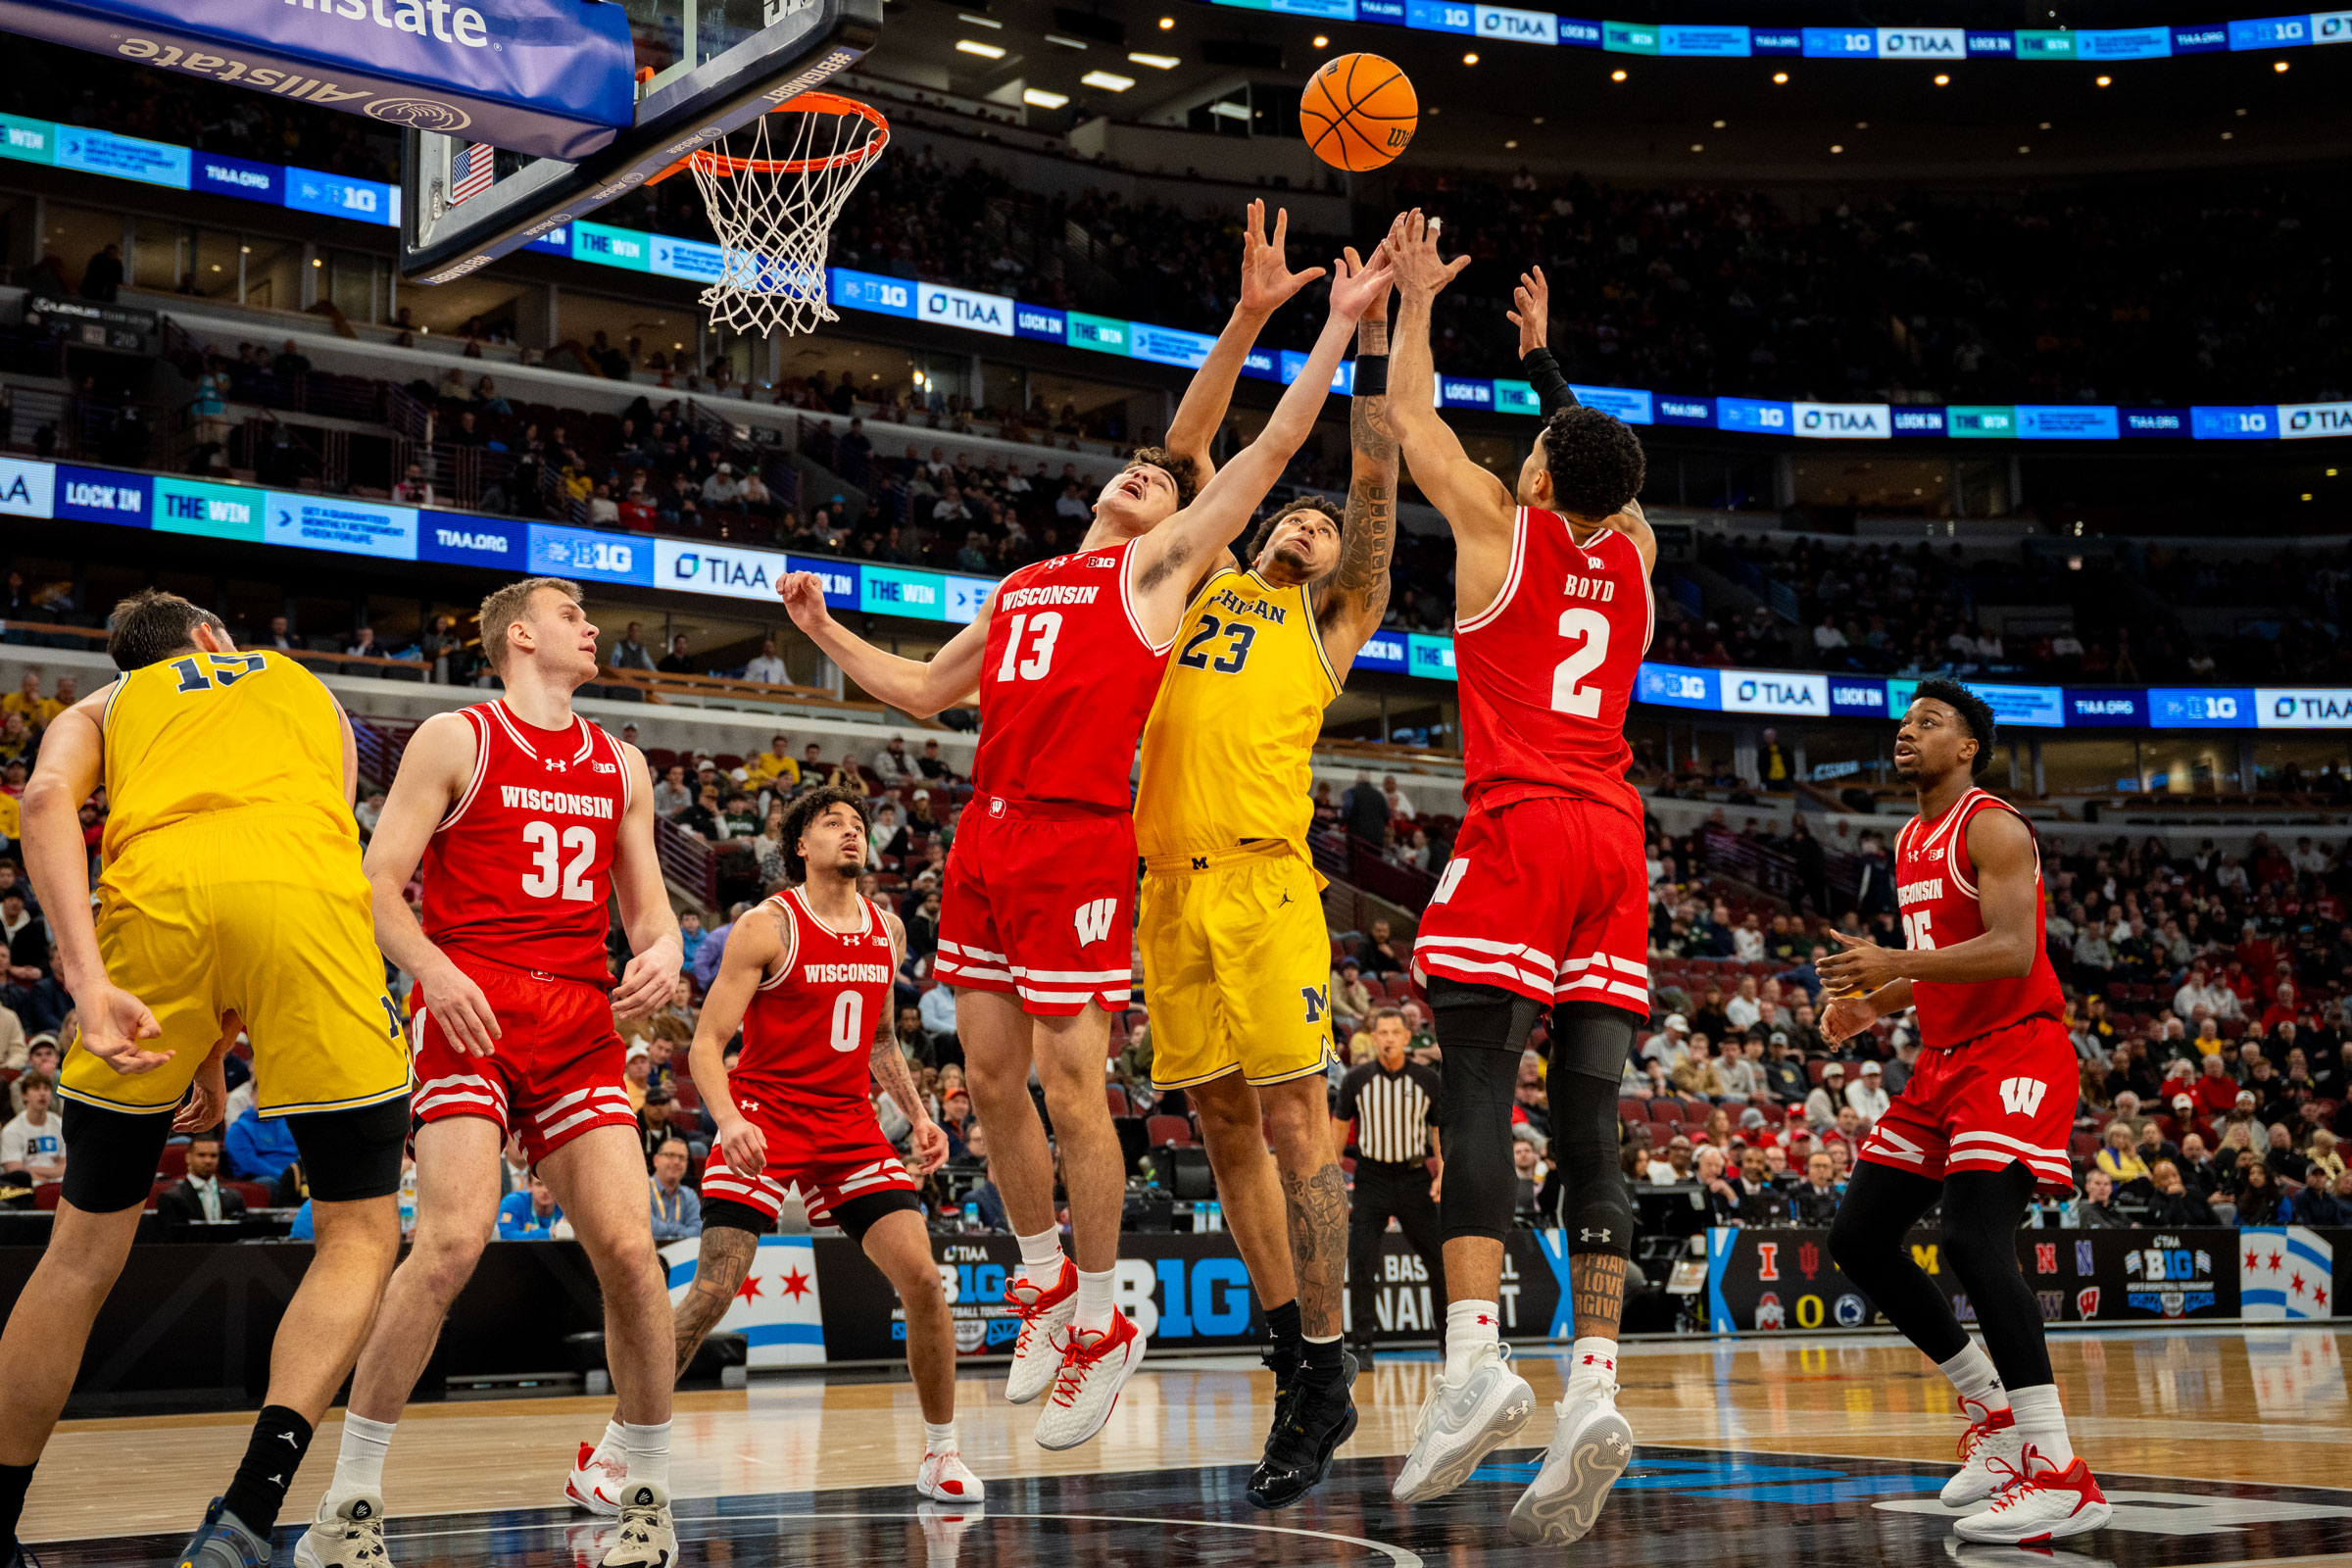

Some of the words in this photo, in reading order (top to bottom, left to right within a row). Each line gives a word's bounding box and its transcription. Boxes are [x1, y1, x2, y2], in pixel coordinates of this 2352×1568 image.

[285, 0, 489, 47] state
[1504, 17, 1547, 37] TIAA
[1907, 35, 1954, 52] TIAA
[119, 38, 373, 103] Allstate
[581, 232, 610, 254] THE
[612, 238, 640, 259] WIN
[952, 298, 1002, 327] TIAA
[1019, 311, 1044, 331] LOCK
[1046, 316, 1063, 335] IN
[1074, 321, 1098, 342] THE
[1099, 326, 1124, 345] WIN
[1827, 412, 1877, 430] TIAA
[2315, 410, 2352, 428] TIA
[66, 482, 115, 510] LOCK
[118, 487, 141, 513] IN
[165, 493, 205, 520] THE
[209, 499, 250, 524] WIN
[436, 529, 508, 553] TIAA.ORG
[705, 559, 769, 588] TIAA
[834, 574, 853, 595] IN
[869, 579, 900, 602] THE
[903, 583, 935, 605] WIN
[1002, 585, 1100, 612] WISCONSIN
[1563, 574, 1615, 603] BOYD
[997, 612, 1063, 682] 13
[1177, 613, 1256, 674] 23
[1388, 642, 1403, 662] IN
[1416, 646, 1441, 667] THE
[169, 652, 267, 694] 15
[1550, 608, 1610, 719] 2
[1763, 683, 1813, 705] TIAA
[1833, 687, 1862, 705] LOCK
[501, 786, 613, 819] WISCONSIN
[521, 821, 596, 902] 32
[1191, 856, 1209, 870] M
[1073, 898, 1117, 949] W
[804, 963, 889, 984] WISCONSIN
[1300, 983, 1331, 1024] M
[830, 990, 863, 1053] 0
[1999, 1076, 2048, 1119] W
[958, 1246, 989, 1262] TIAA
[1911, 1244, 1940, 1275] M
[2034, 1243, 2058, 1274] N
[2076, 1240, 2095, 1276] N
[1795, 1294, 1825, 1329] O
[2078, 1287, 2100, 1321] W
